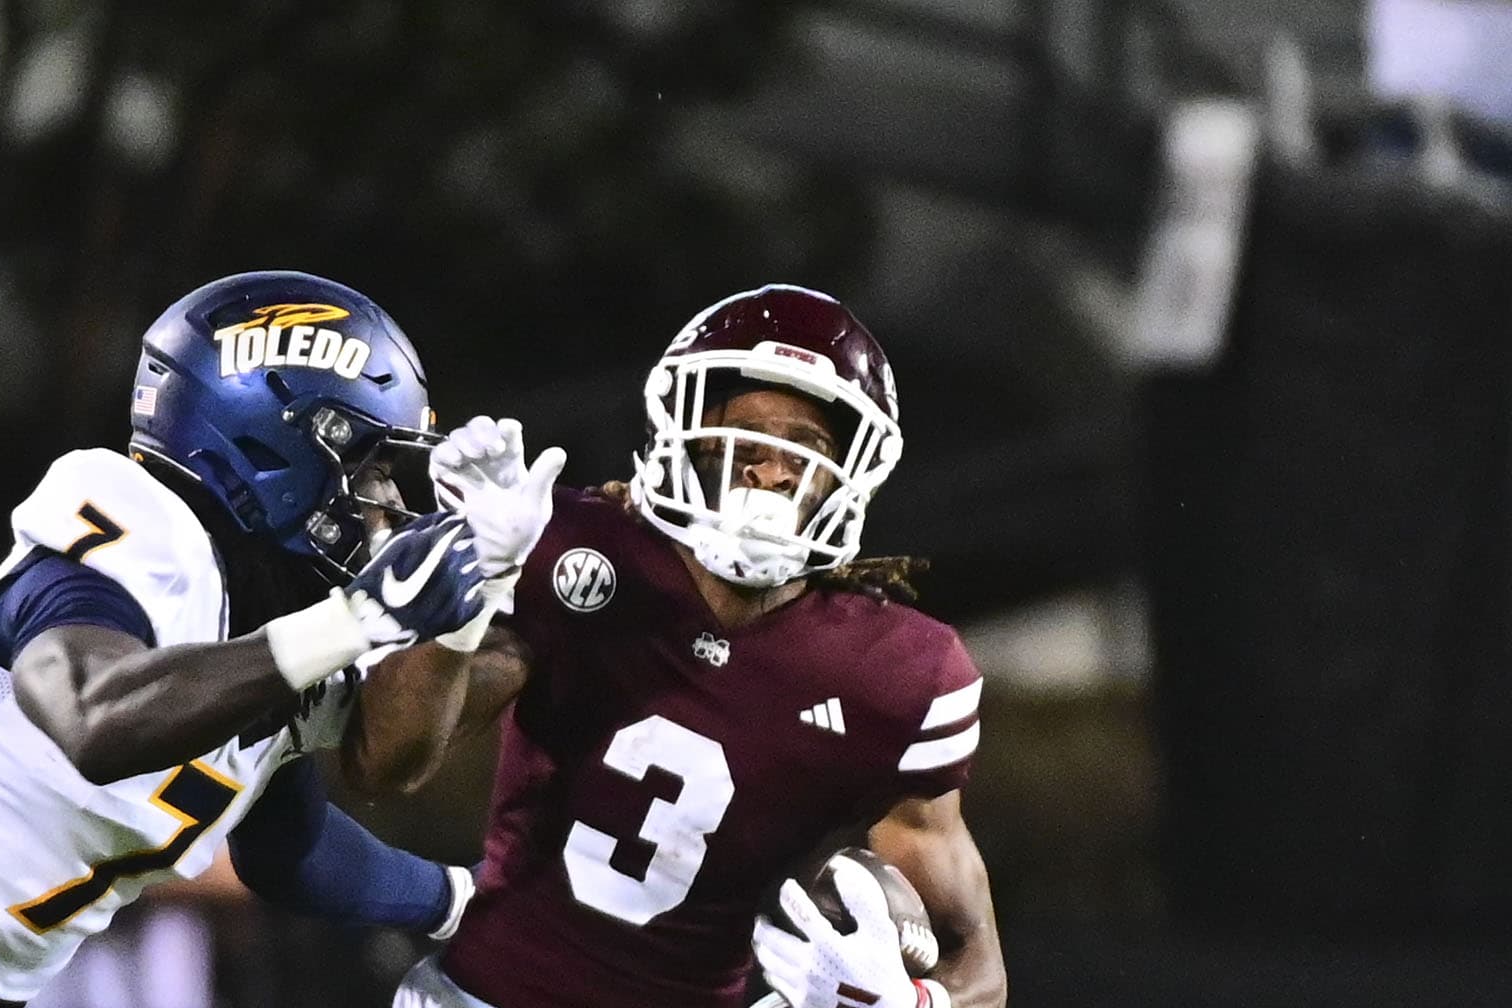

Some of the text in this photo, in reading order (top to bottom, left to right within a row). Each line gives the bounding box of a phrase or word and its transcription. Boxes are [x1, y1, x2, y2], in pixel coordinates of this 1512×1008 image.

[213, 323, 371, 380] TOLEDO
[64, 499, 129, 566] 7
[557, 552, 612, 608] SEC
[6, 756, 245, 935] 7
[562, 714, 735, 926] 3
